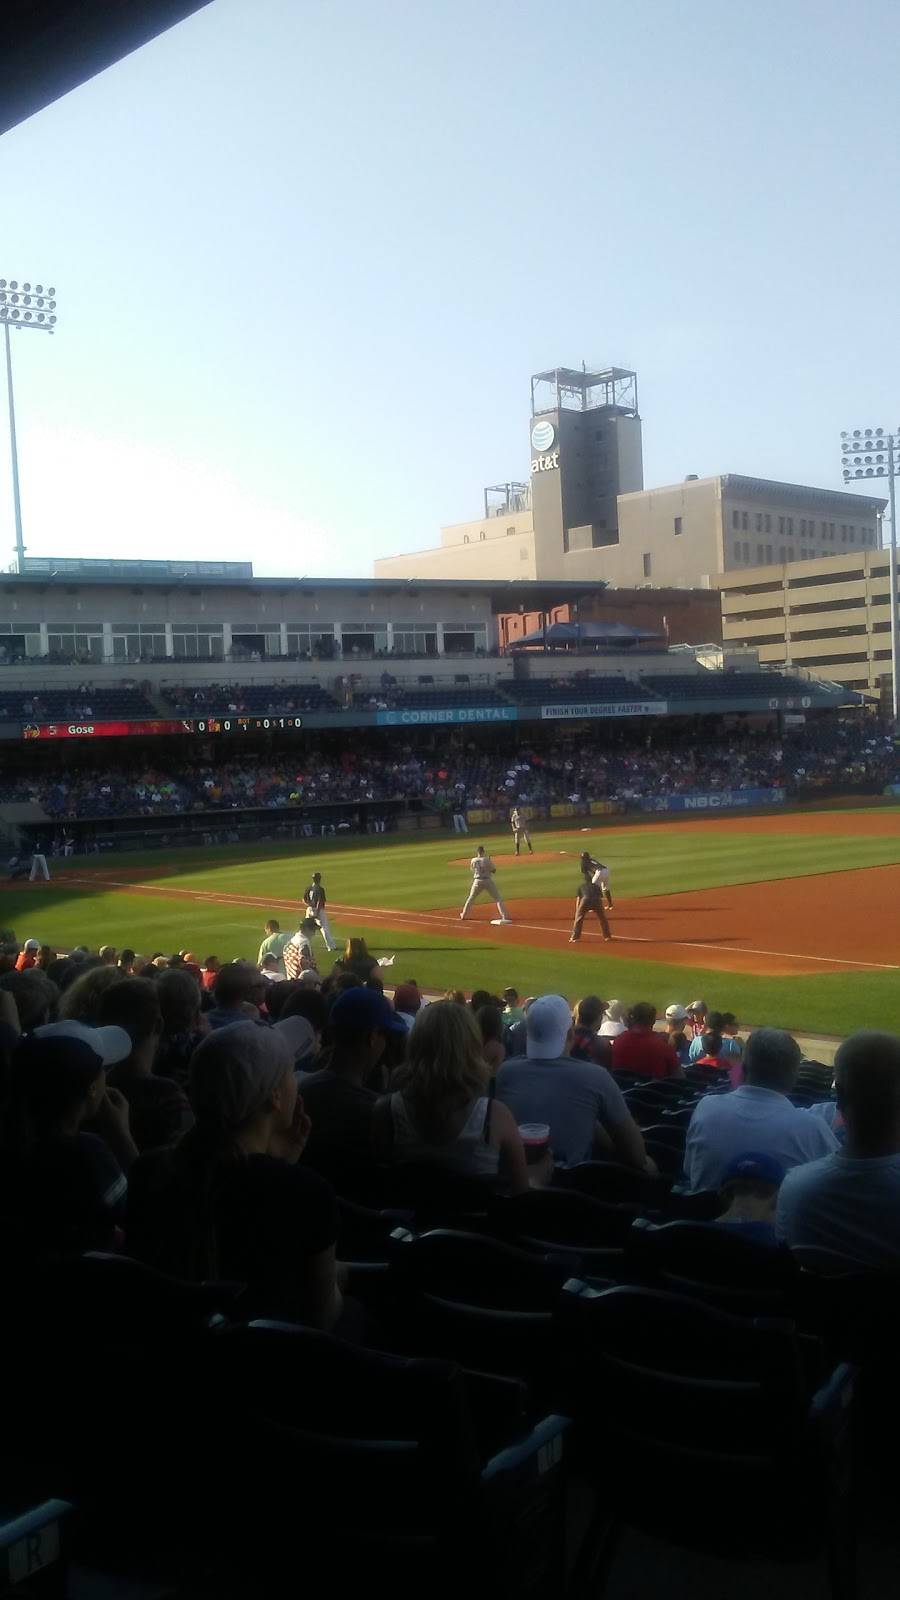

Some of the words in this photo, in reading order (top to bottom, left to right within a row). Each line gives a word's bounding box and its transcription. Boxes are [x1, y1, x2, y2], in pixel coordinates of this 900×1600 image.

[531, 453, 559, 473] at&t
[401, 711, 454, 722] CORNER
[458, 709, 509, 721] DENTAL
[198, 721, 206, 731] 0
[223, 720, 231, 730] 0
[263, 718, 270, 728] 0
[279, 718, 284, 728] 1
[294, 718, 302, 728] 0
[68, 725, 94, 734] Gose
